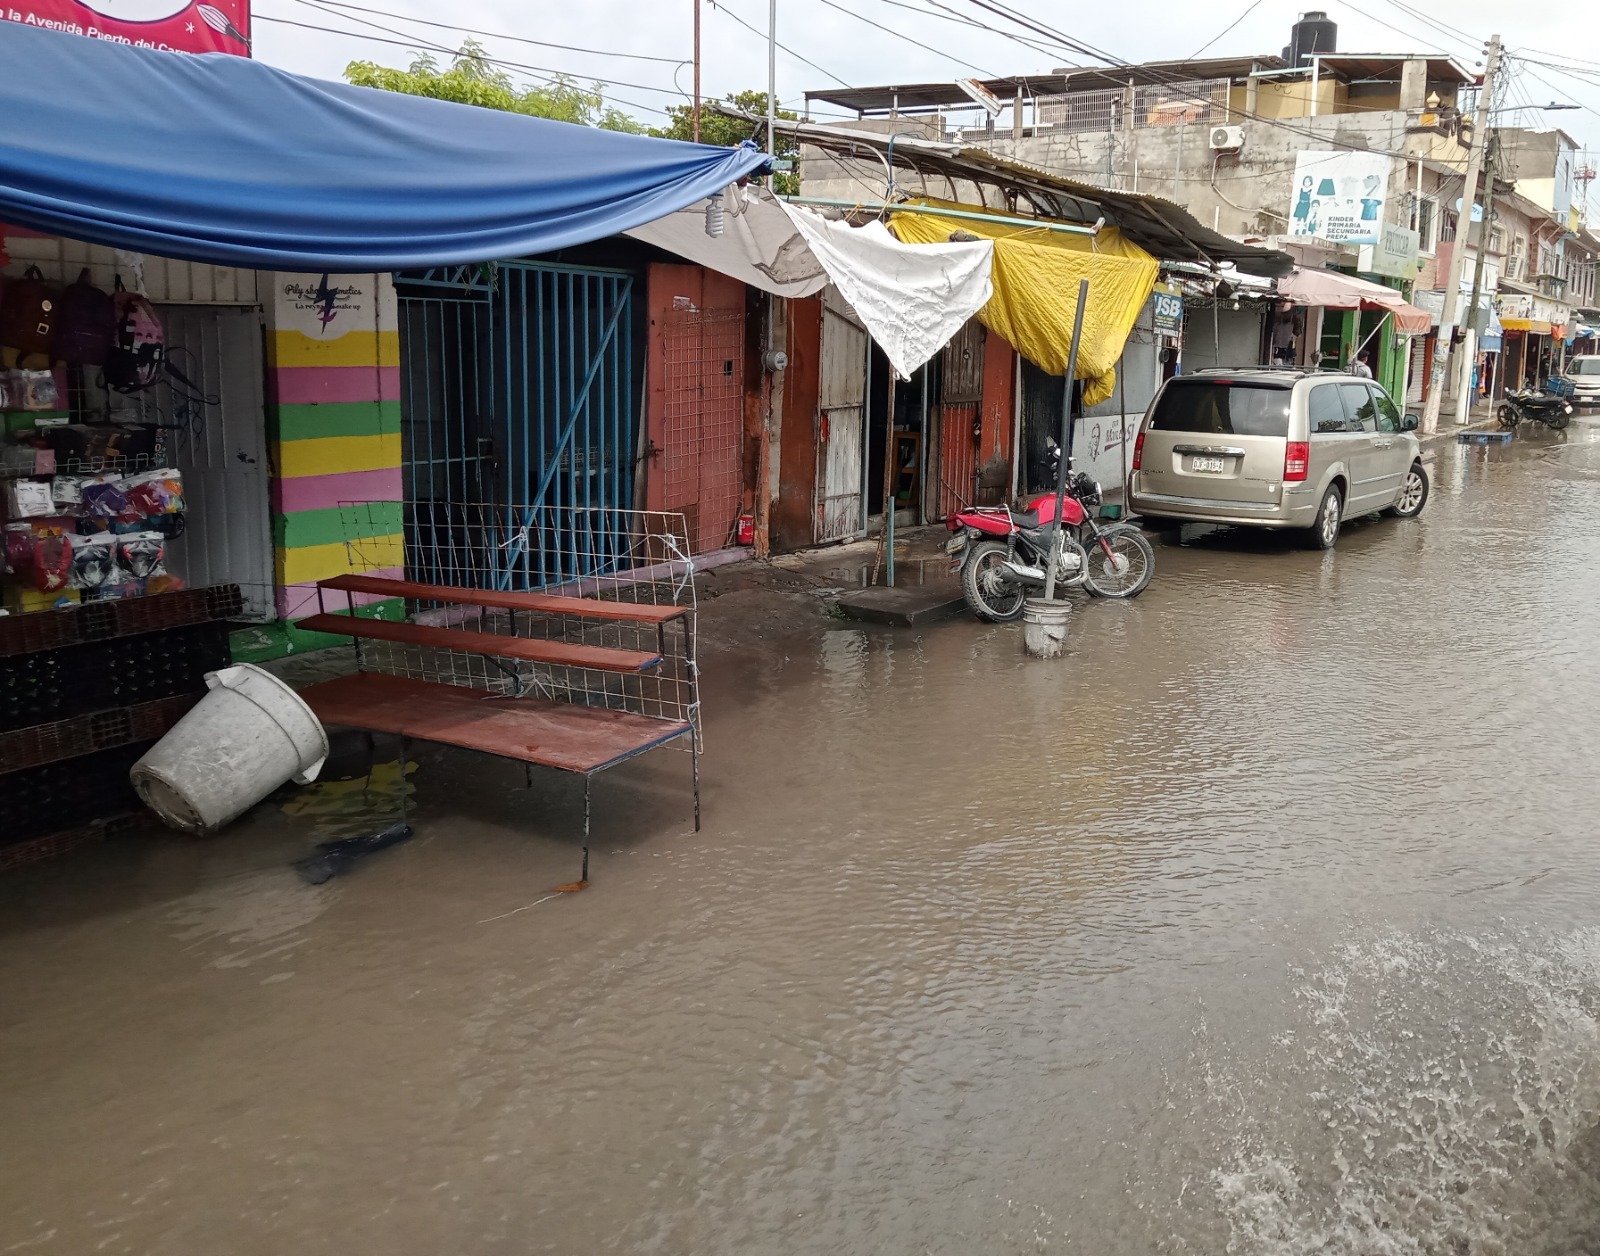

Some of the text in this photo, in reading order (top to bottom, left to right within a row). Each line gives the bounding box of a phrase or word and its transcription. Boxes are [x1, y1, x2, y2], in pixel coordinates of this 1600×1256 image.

[8, 8, 21, 22] la
[25, 13, 83, 36] Avenida
[87, 26, 132, 46] Puerto
[134, 38, 155, 50] del
[285, 283, 304, 299] Pily
[305, 284, 319, 295] sho
